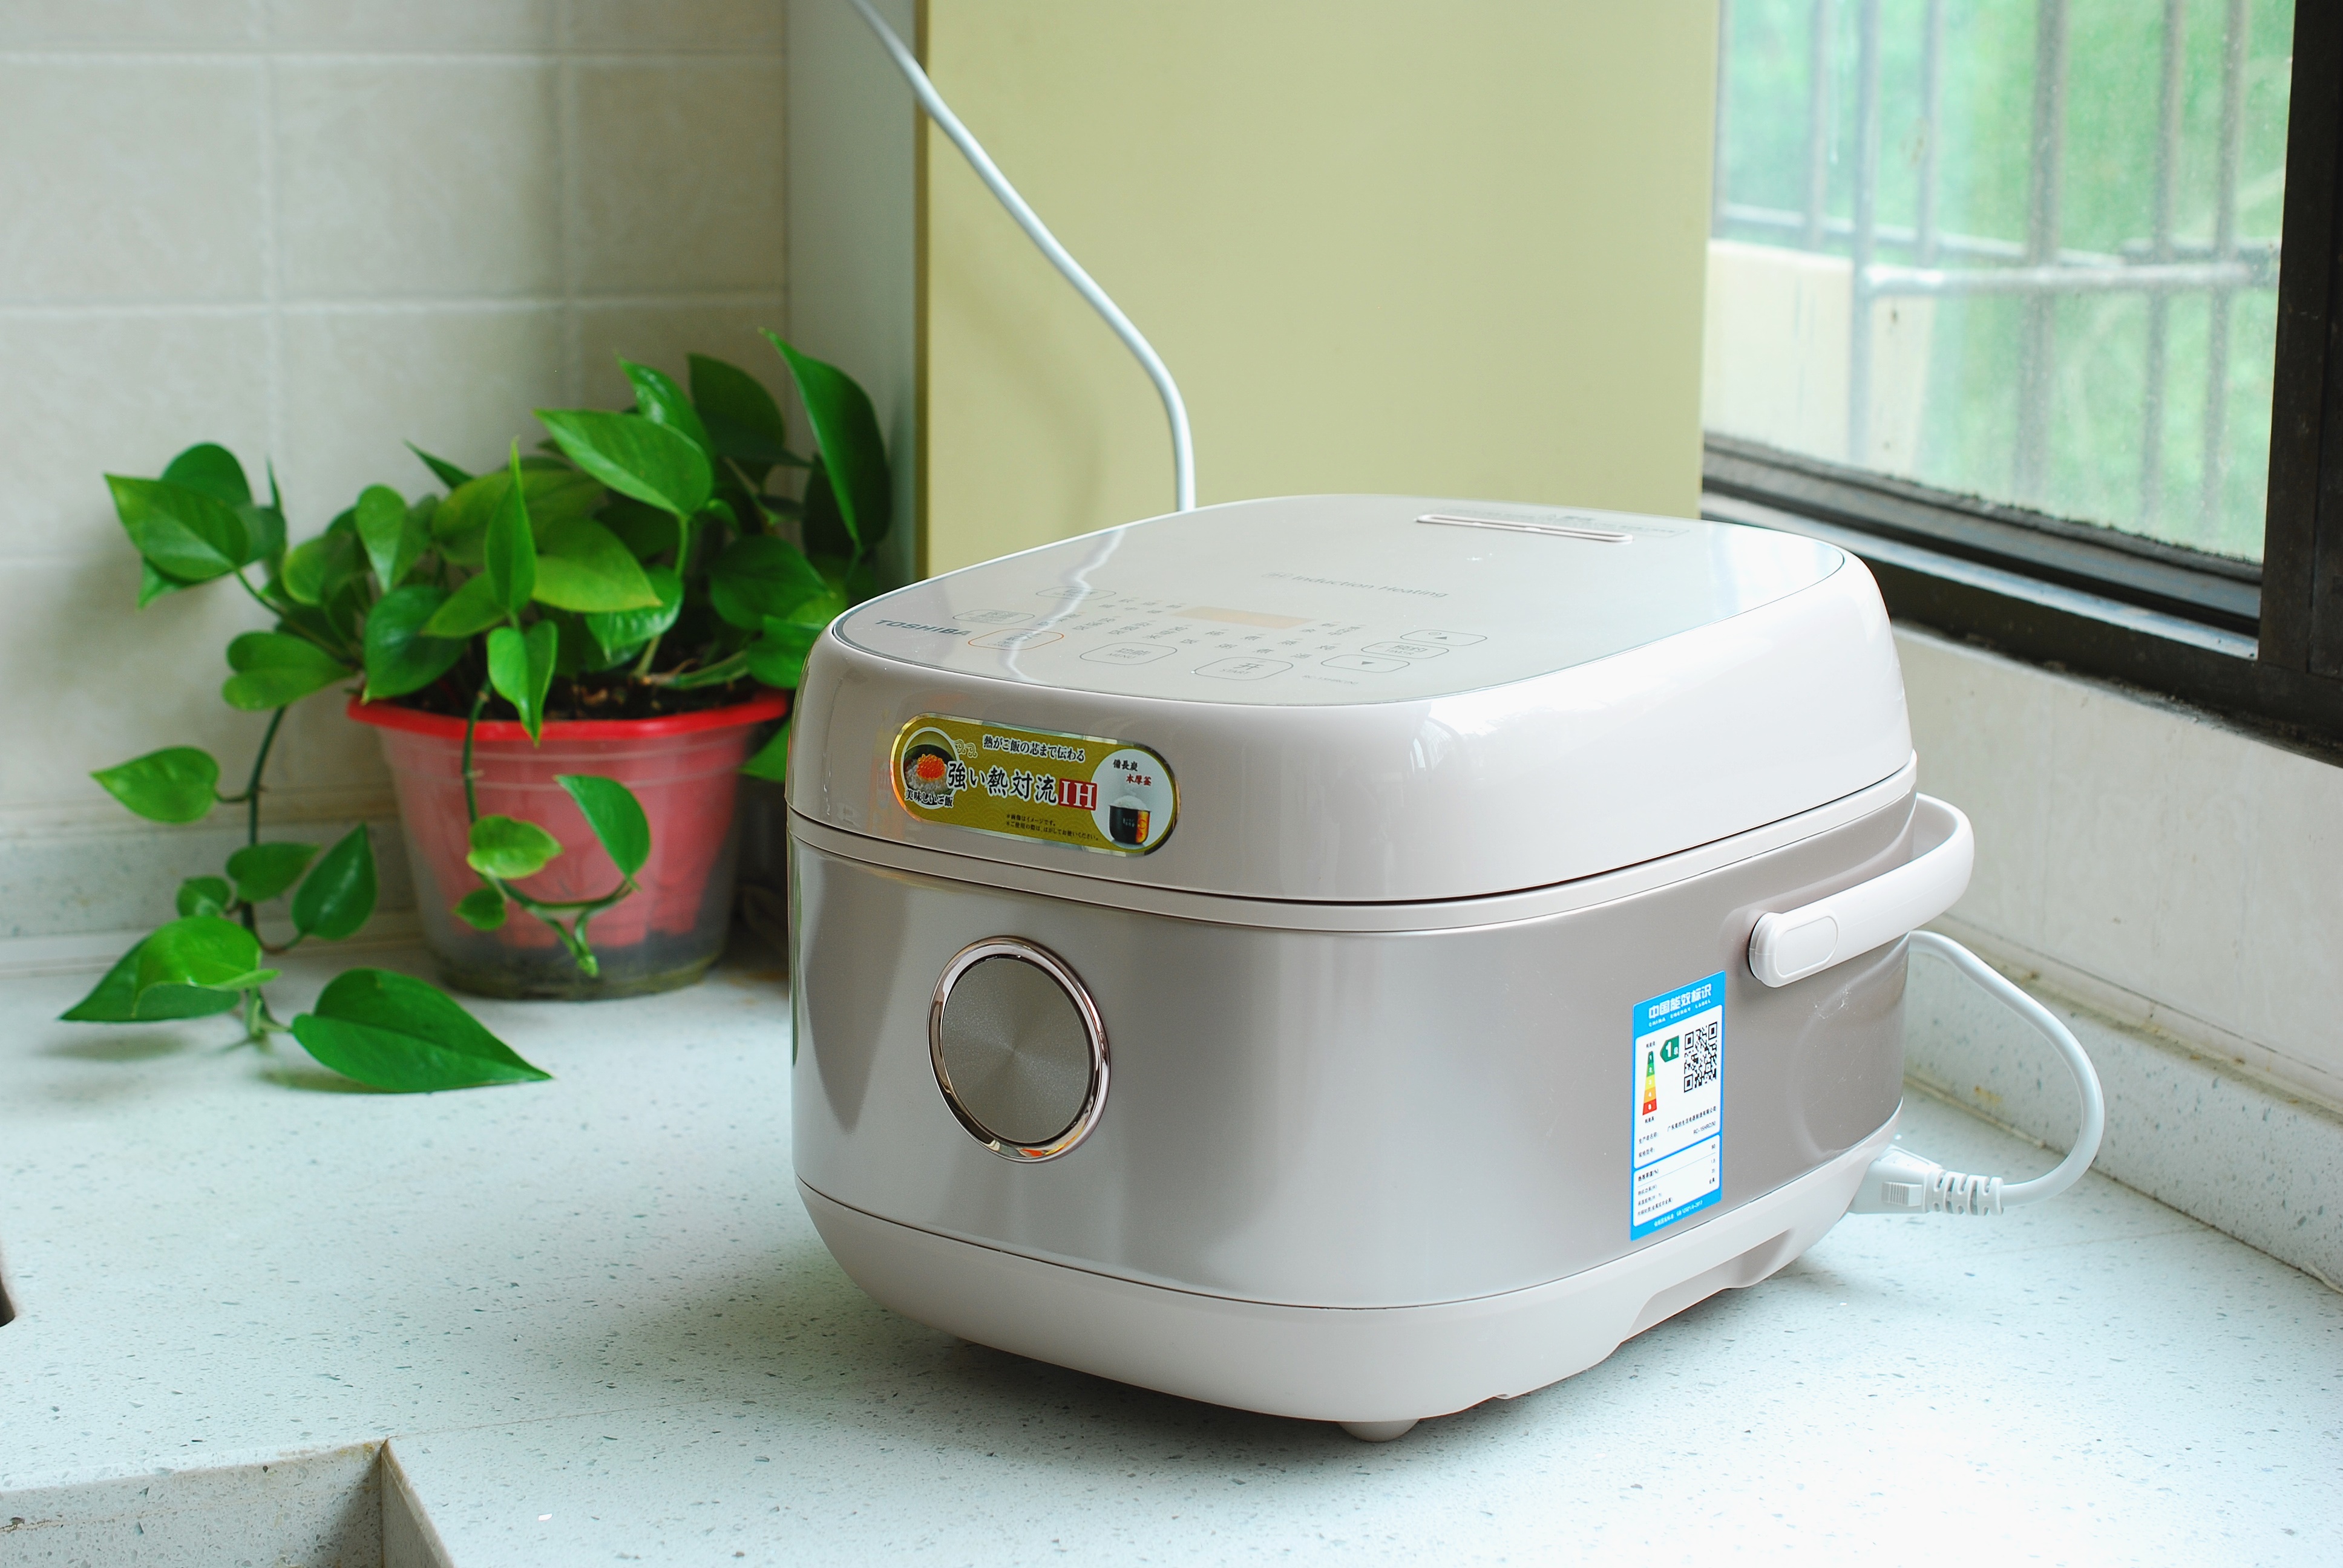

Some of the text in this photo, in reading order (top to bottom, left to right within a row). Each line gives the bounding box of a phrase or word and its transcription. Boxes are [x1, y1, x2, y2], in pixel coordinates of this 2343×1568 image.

[1292, 575, 1374, 589] Induction
[1378, 585, 1449, 598] Heating
[875, 619, 972, 636] TOSHIBA
[983, 734, 1086, 762] 熱がご飯の芯まで伝わる
[1113, 759, 1138, 772] 備長炭
[905, 789, 954, 808] 美味しいご飯
[1648, 983, 1712, 1019] 中国能效标识
[1648, 999, 1711, 1027] CHINA ENERGY LABEL
